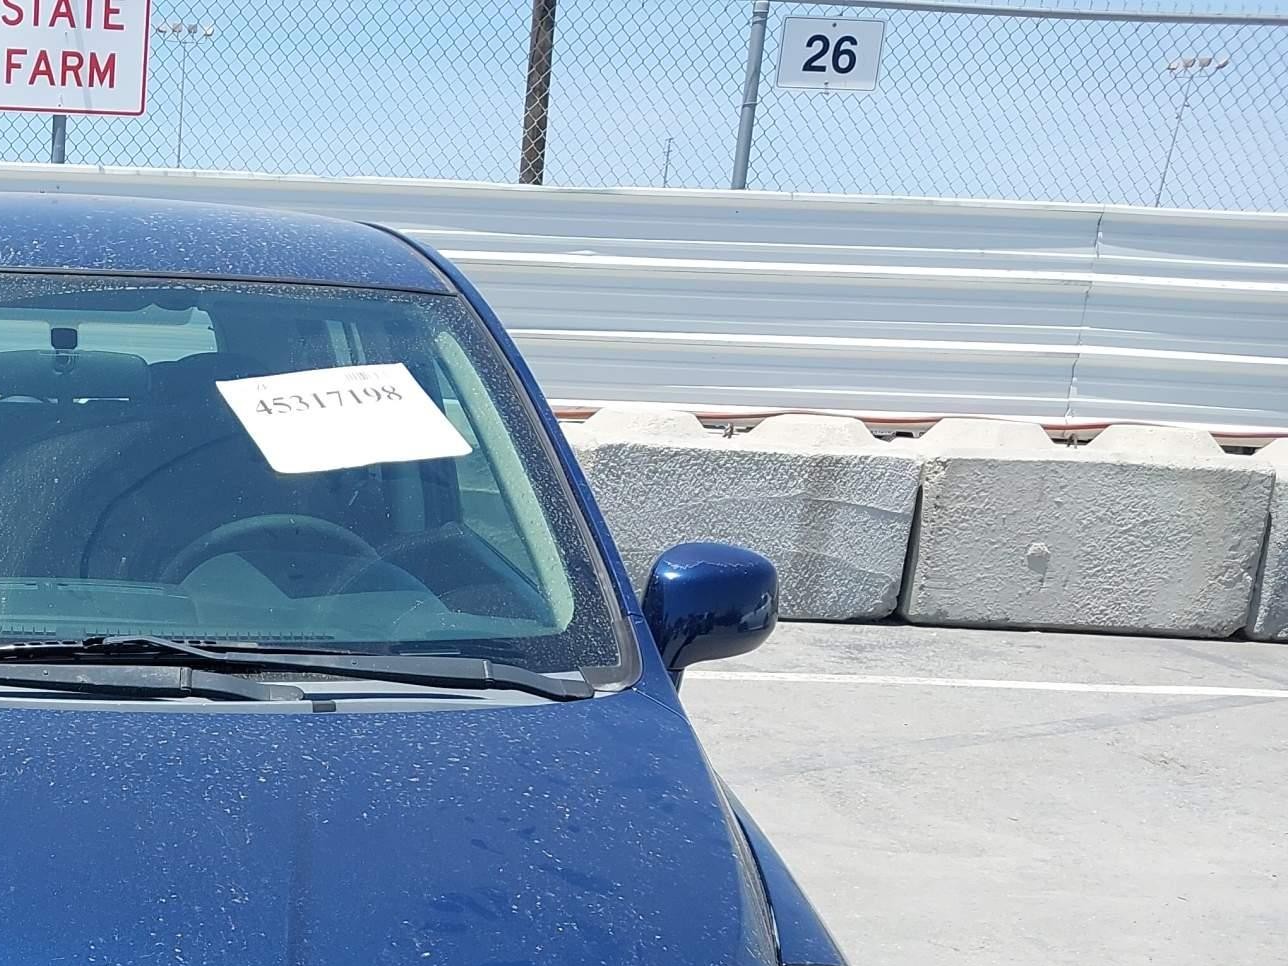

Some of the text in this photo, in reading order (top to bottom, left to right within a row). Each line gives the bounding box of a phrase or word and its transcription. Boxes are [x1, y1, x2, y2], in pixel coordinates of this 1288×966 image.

[5, 48, 116, 89] FARM
[801, 34, 858, 74] 26
[255, 384, 403, 415] 45317198
